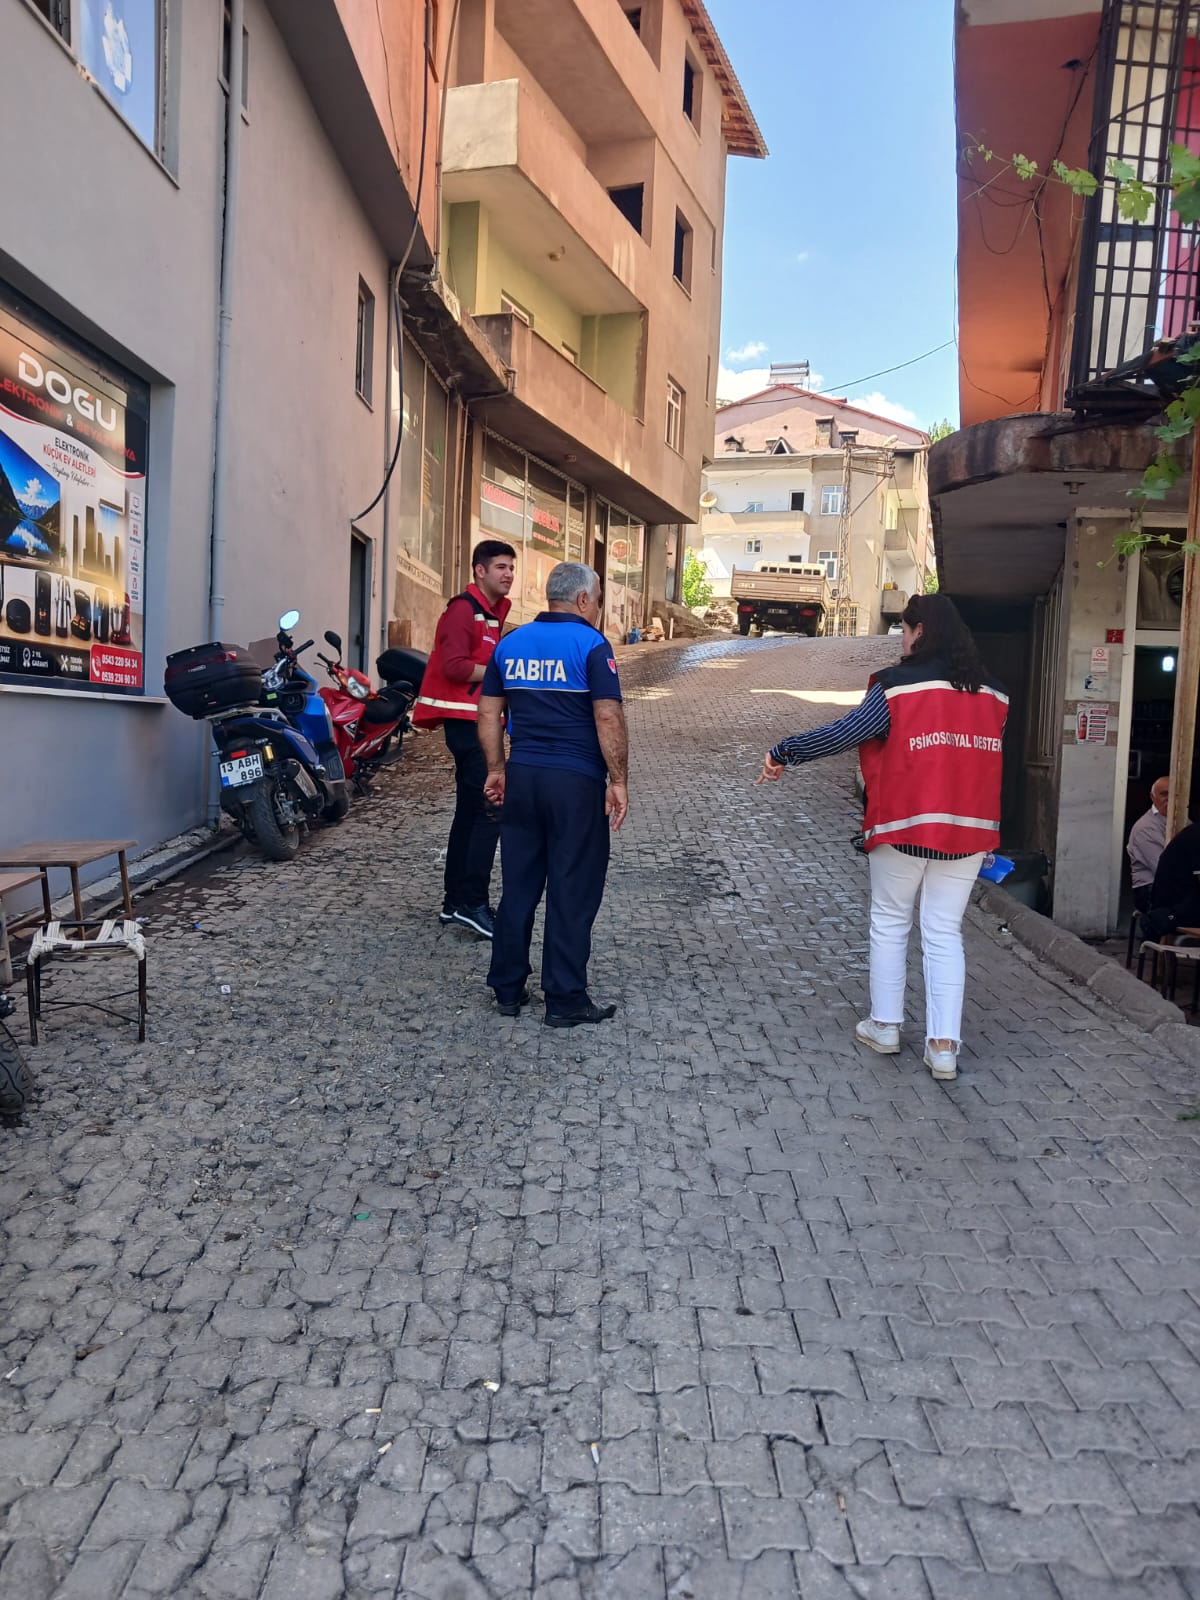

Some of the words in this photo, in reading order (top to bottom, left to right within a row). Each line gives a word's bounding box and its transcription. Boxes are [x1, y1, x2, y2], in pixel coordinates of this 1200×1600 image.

[66, 413, 74, 428] &
[63, 454, 72, 466] EV
[504, 658, 567, 682] ZABITA
[909, 731, 972, 751] PSİKOSOSYAL
[222, 762, 234, 774] 13
[238, 754, 259, 770] ABH
[240, 767, 262, 780] 896
